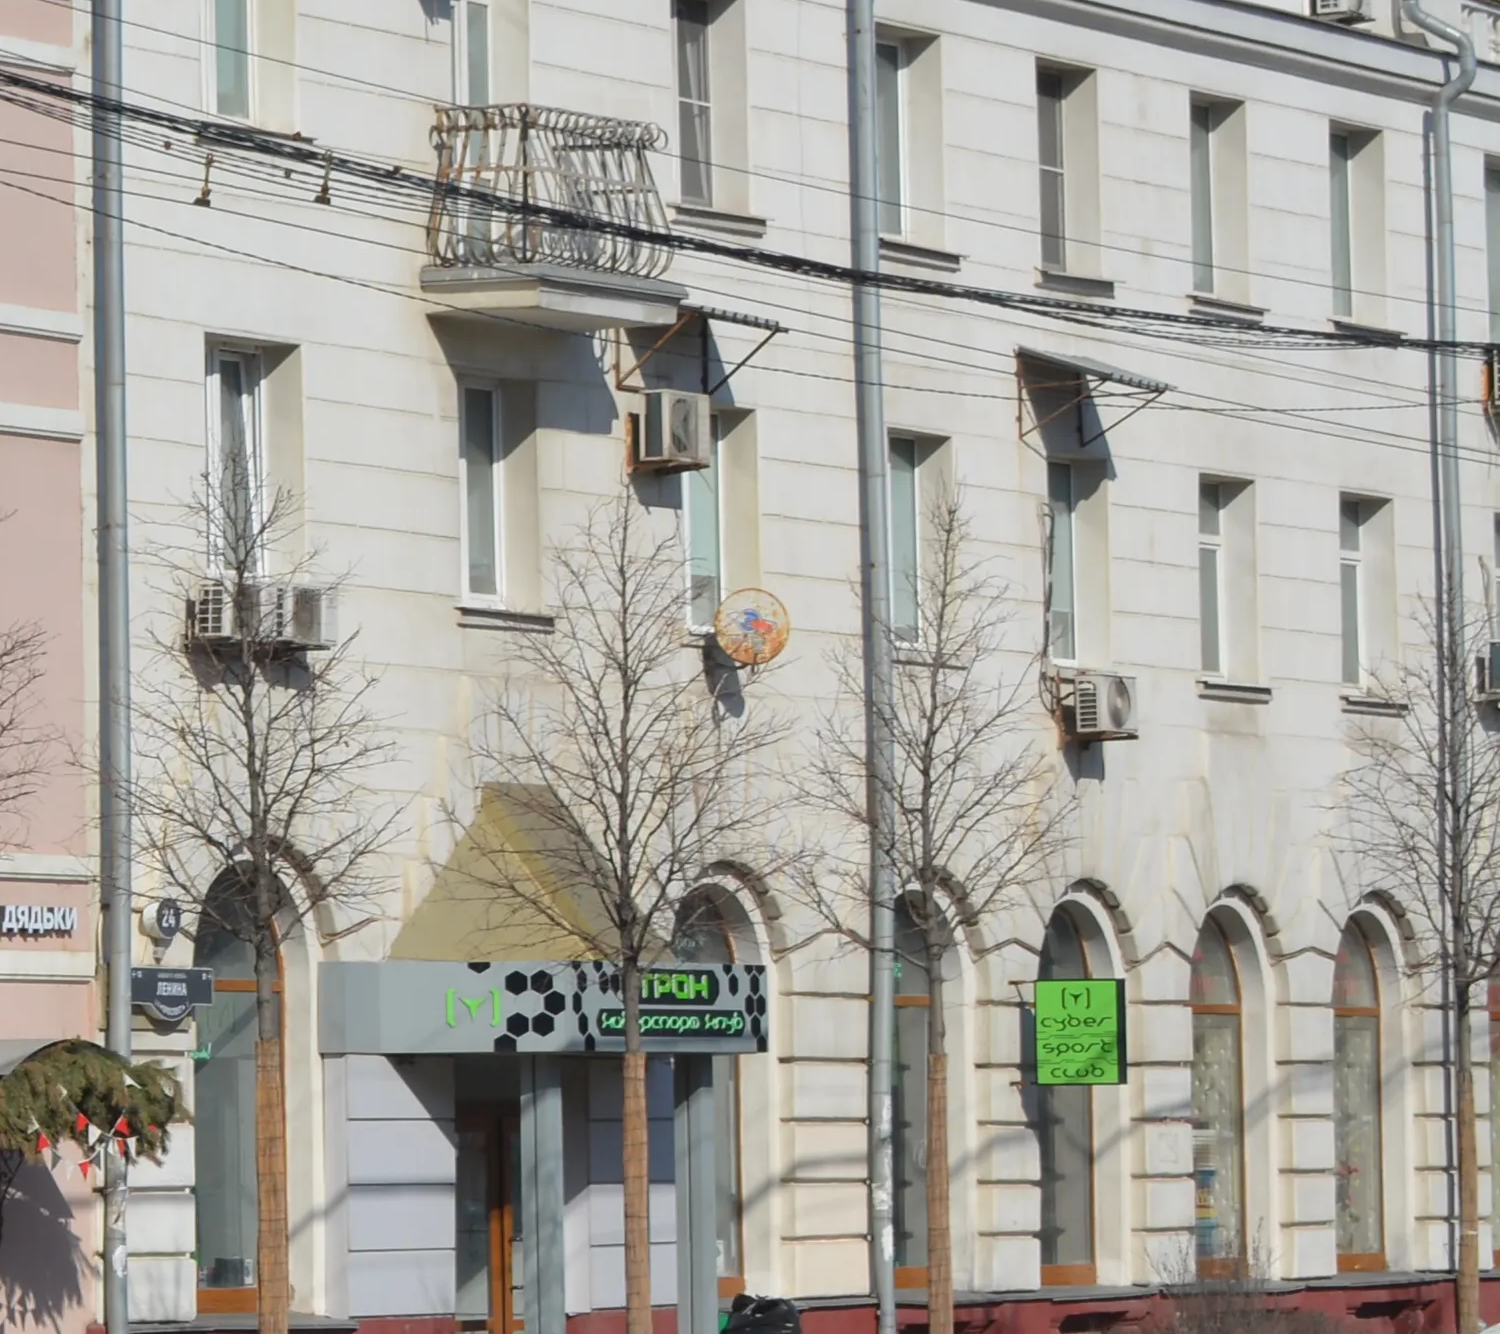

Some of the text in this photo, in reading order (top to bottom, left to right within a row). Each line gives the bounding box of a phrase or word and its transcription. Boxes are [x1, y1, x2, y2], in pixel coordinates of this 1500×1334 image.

[2, 904, 78, 933] ДЯДЬКИ
[161, 907, 176, 928] 24
[156, 981, 188, 996] ЛЕНИНА
[1040, 1013, 1113, 1032] cyber
[1042, 1039, 1113, 1057] sport
